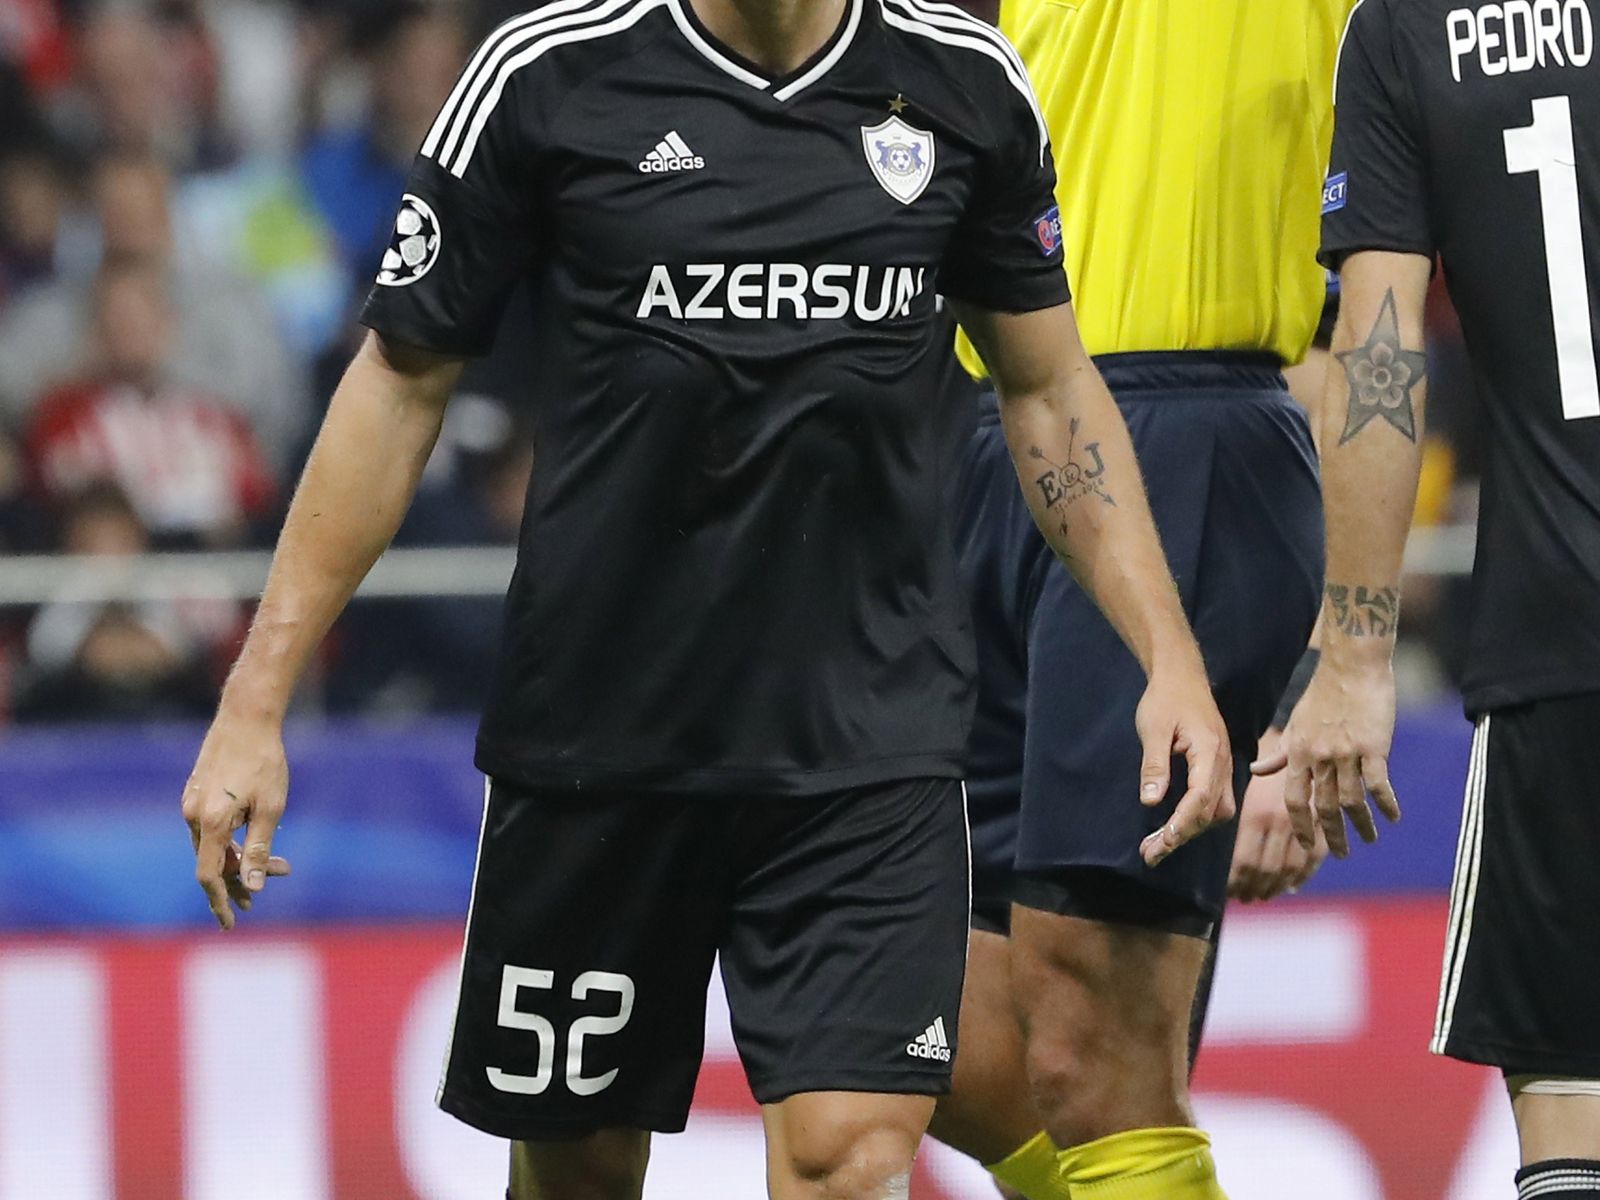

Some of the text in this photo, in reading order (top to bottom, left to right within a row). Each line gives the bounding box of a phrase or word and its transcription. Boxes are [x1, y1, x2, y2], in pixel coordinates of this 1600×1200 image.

[639, 156, 705, 173] adidas
[1322, 182, 1345, 204] ECT
[1503, 95, 1600, 421] 1
[636, 264, 925, 322] AZERSUN
[485, 963, 636, 1096] 52
[906, 1043, 951, 1062] adidas
